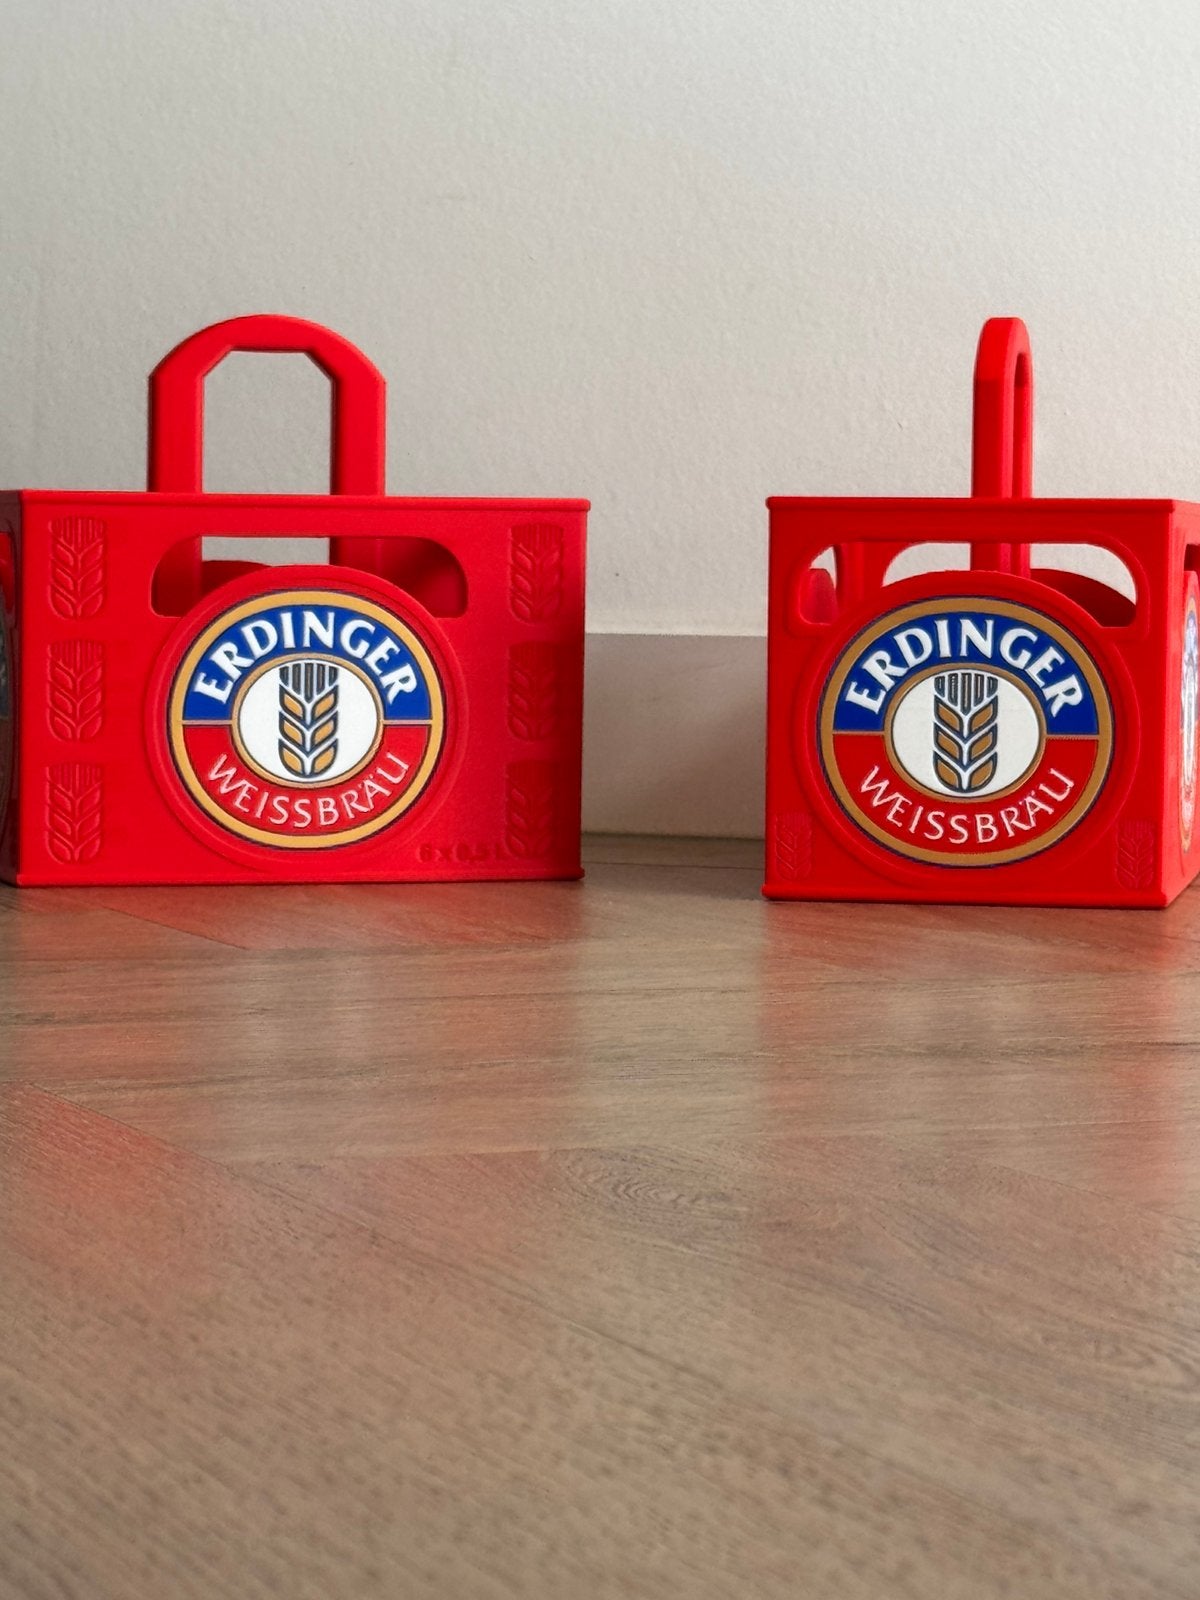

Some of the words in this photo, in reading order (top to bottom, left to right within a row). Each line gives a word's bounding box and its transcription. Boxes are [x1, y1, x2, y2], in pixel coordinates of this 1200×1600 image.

[194, 610, 418, 704] ERDINGER
[845, 618, 1084, 717] ERDINGER
[207, 752, 410, 828] WEISSBRÄU
[860, 766, 1075, 844] WEISSBRÄU
